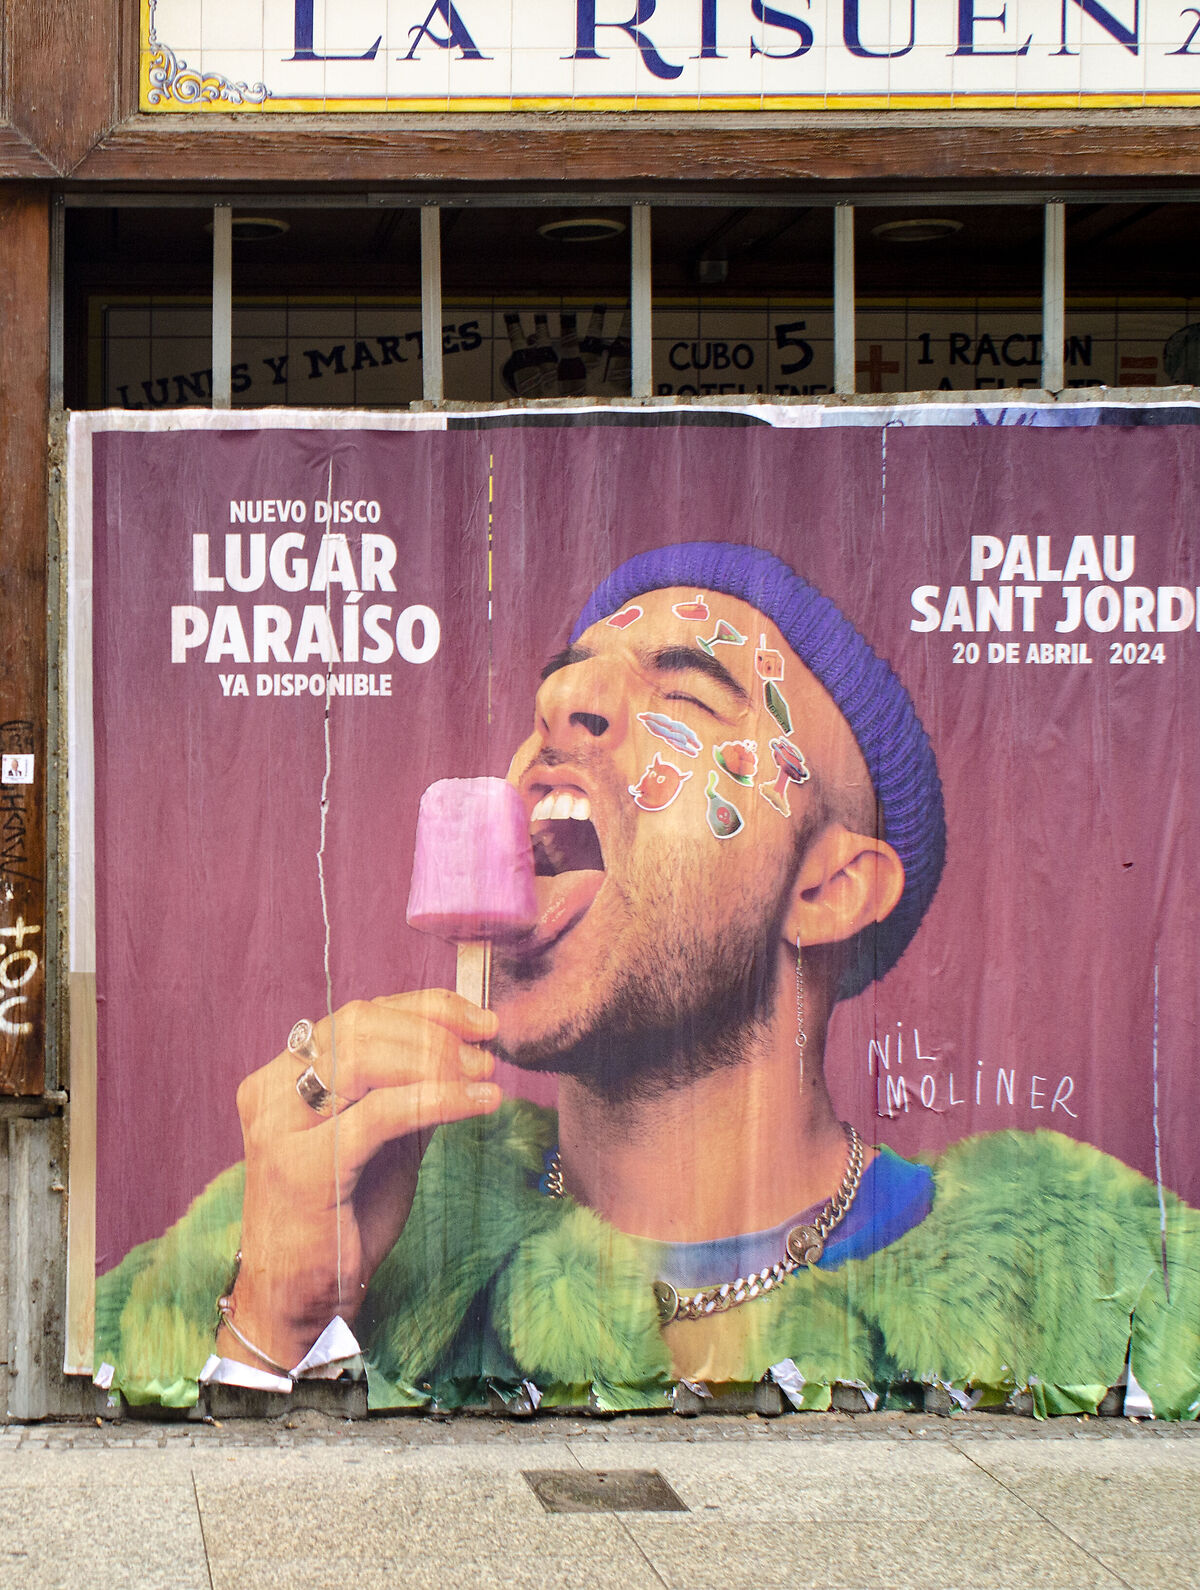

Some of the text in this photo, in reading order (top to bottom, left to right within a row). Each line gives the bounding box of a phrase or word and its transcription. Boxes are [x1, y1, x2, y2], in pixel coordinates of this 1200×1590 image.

[263, 354, 290, 385] Y
[668, 321, 814, 376] CUBO 5
[917, 333, 1092, 368] 1 RACIN
[230, 500, 381, 524] NUEVO DISCO
[193, 532, 397, 593] LUGAR
[969, 534, 1136, 583] PALAU
[171, 590, 441, 664] PARAÍSO
[909, 584, 1200, 634] SANT JORD
[952, 642, 1167, 665] 20 DE ABRIL 2024
[218, 673, 393, 697] YA DISPONIBLE
